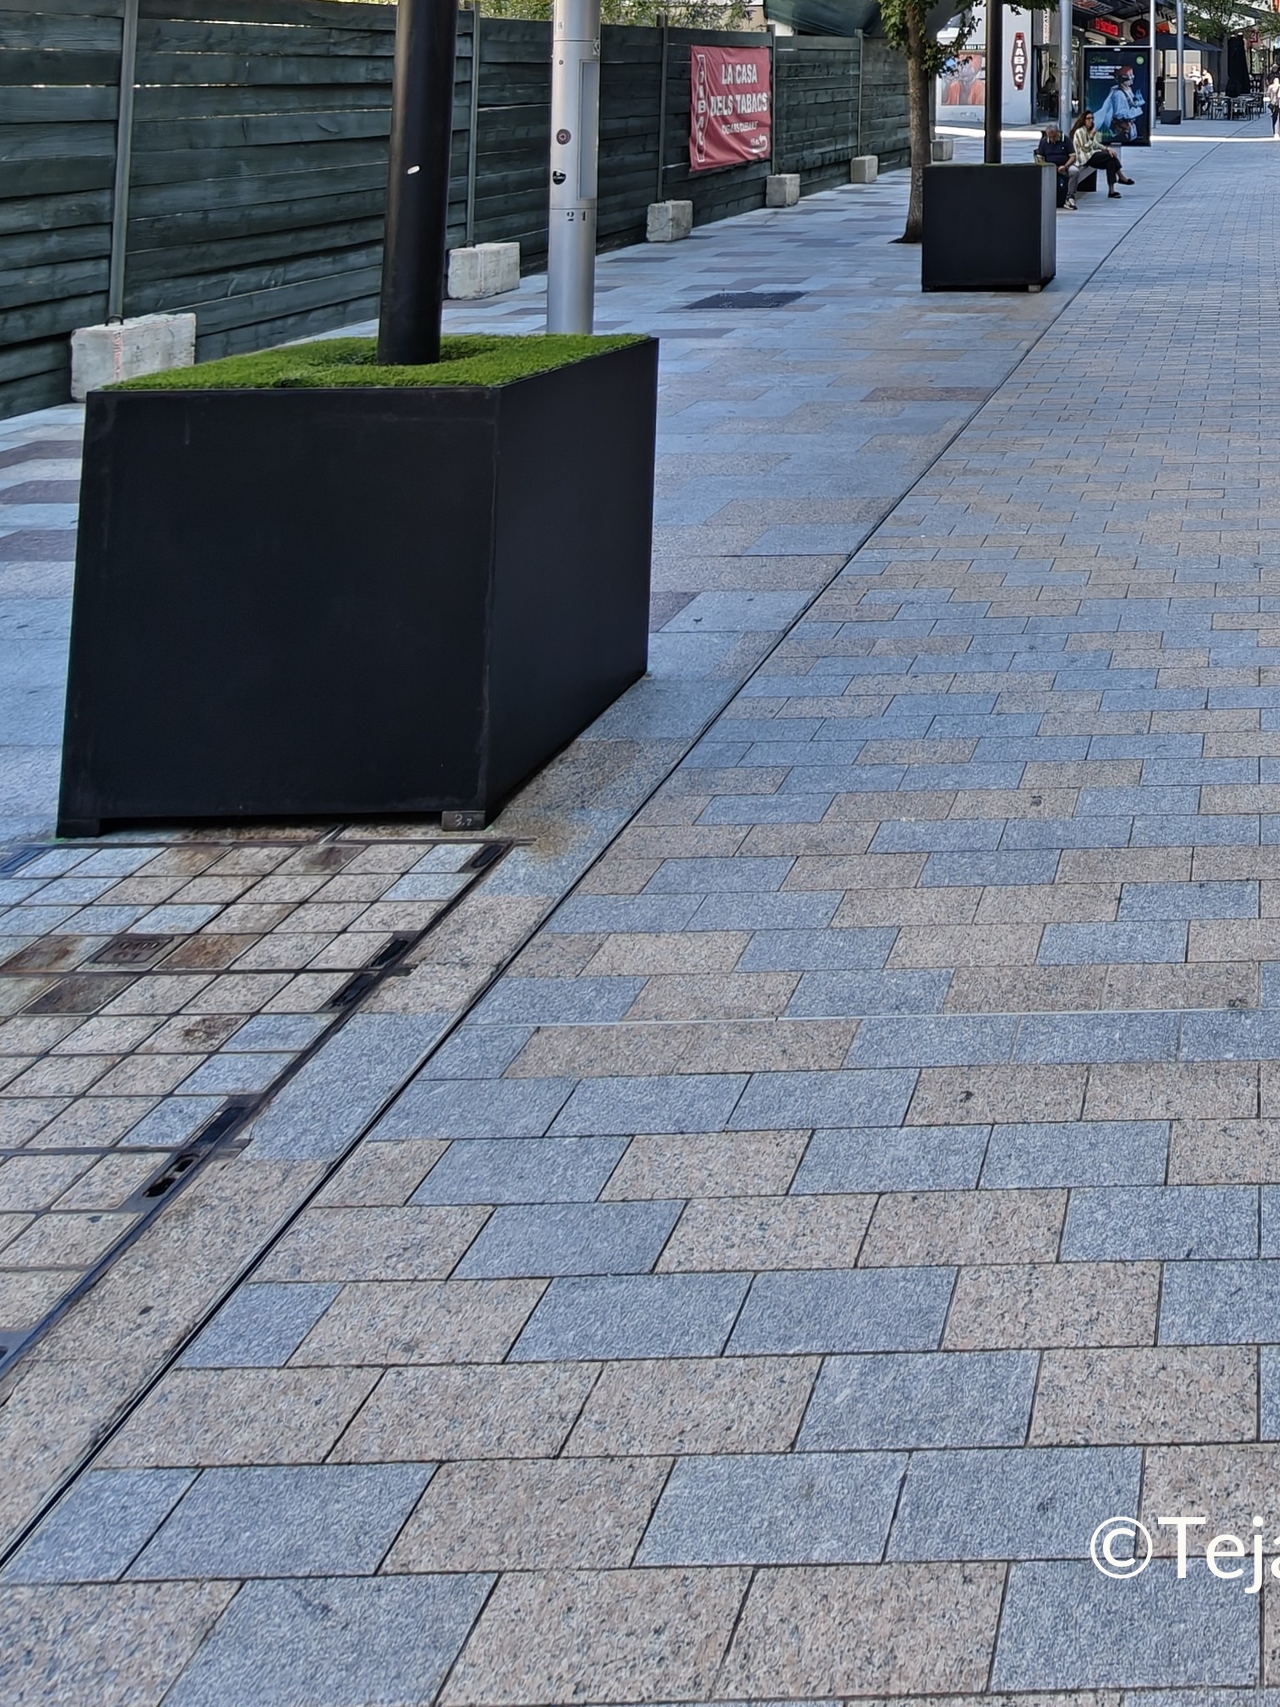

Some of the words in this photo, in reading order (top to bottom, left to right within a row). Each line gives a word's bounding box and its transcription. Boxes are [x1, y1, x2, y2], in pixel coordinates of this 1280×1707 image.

[1014, 39, 1024, 83] TABAC
[721, 64, 733, 85] LA
[735, 63, 758, 84] CASA
[710, 94, 733, 117] DELS
[735, 92, 768, 115] TABACS
